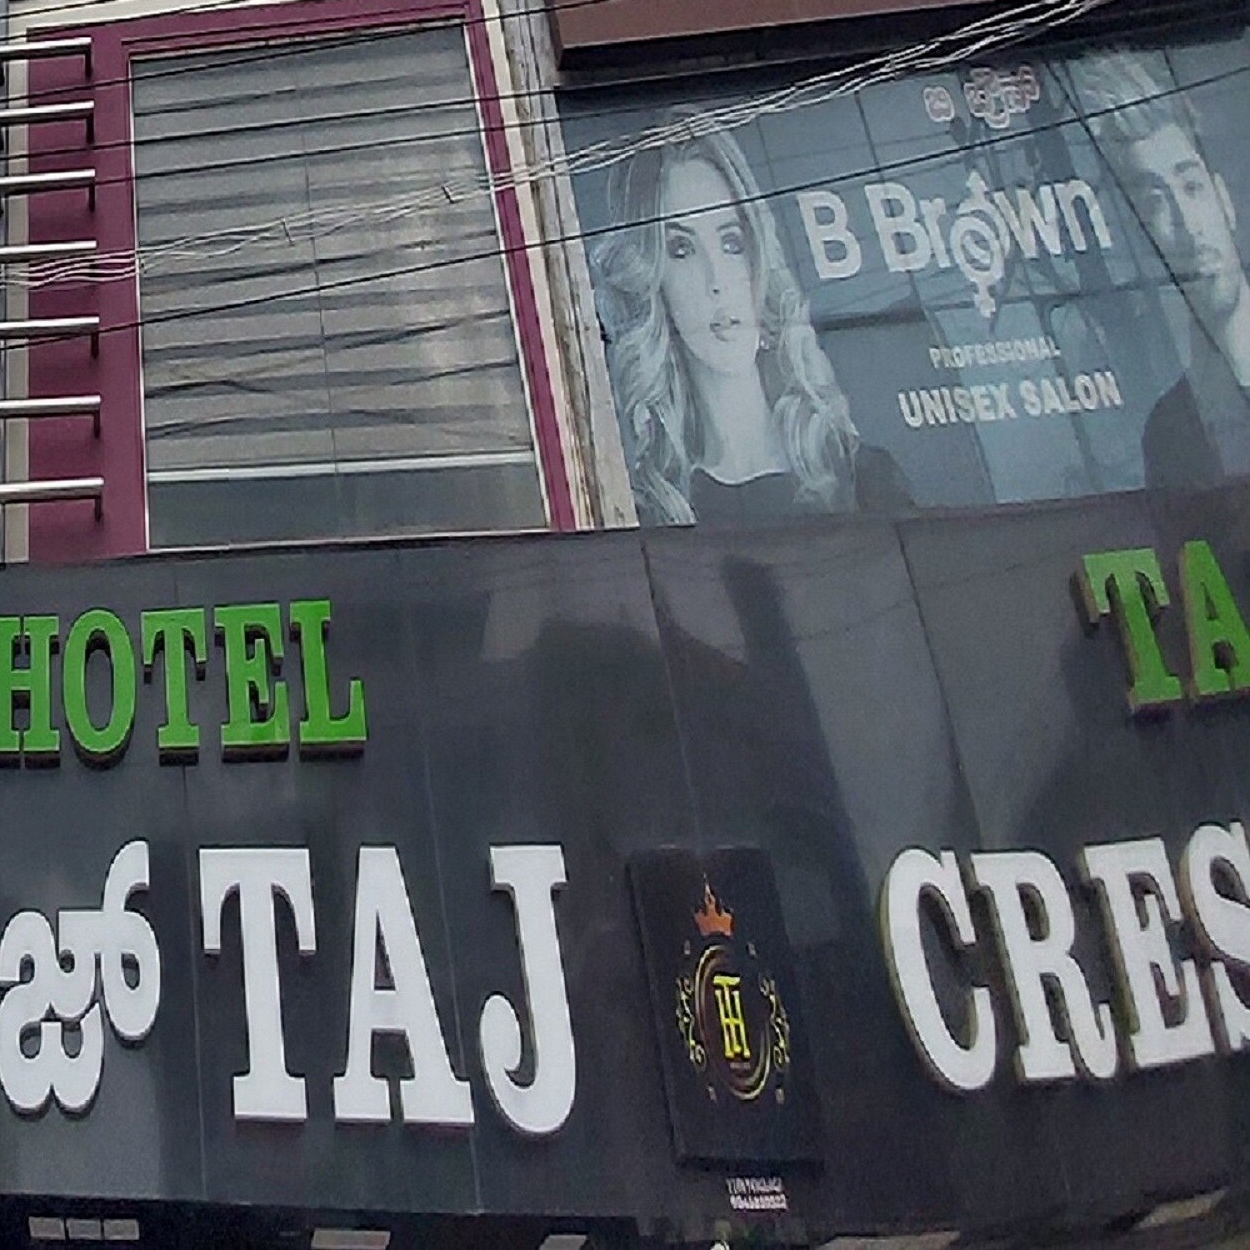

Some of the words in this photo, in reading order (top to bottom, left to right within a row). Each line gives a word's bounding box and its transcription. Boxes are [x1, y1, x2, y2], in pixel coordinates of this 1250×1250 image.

[928, 336, 1062, 369] PROFESSIONAL
[898, 383, 1018, 428] UNISEX
[1018, 370, 1124, 417] SALON
[198, 843, 577, 1134] TAJ
